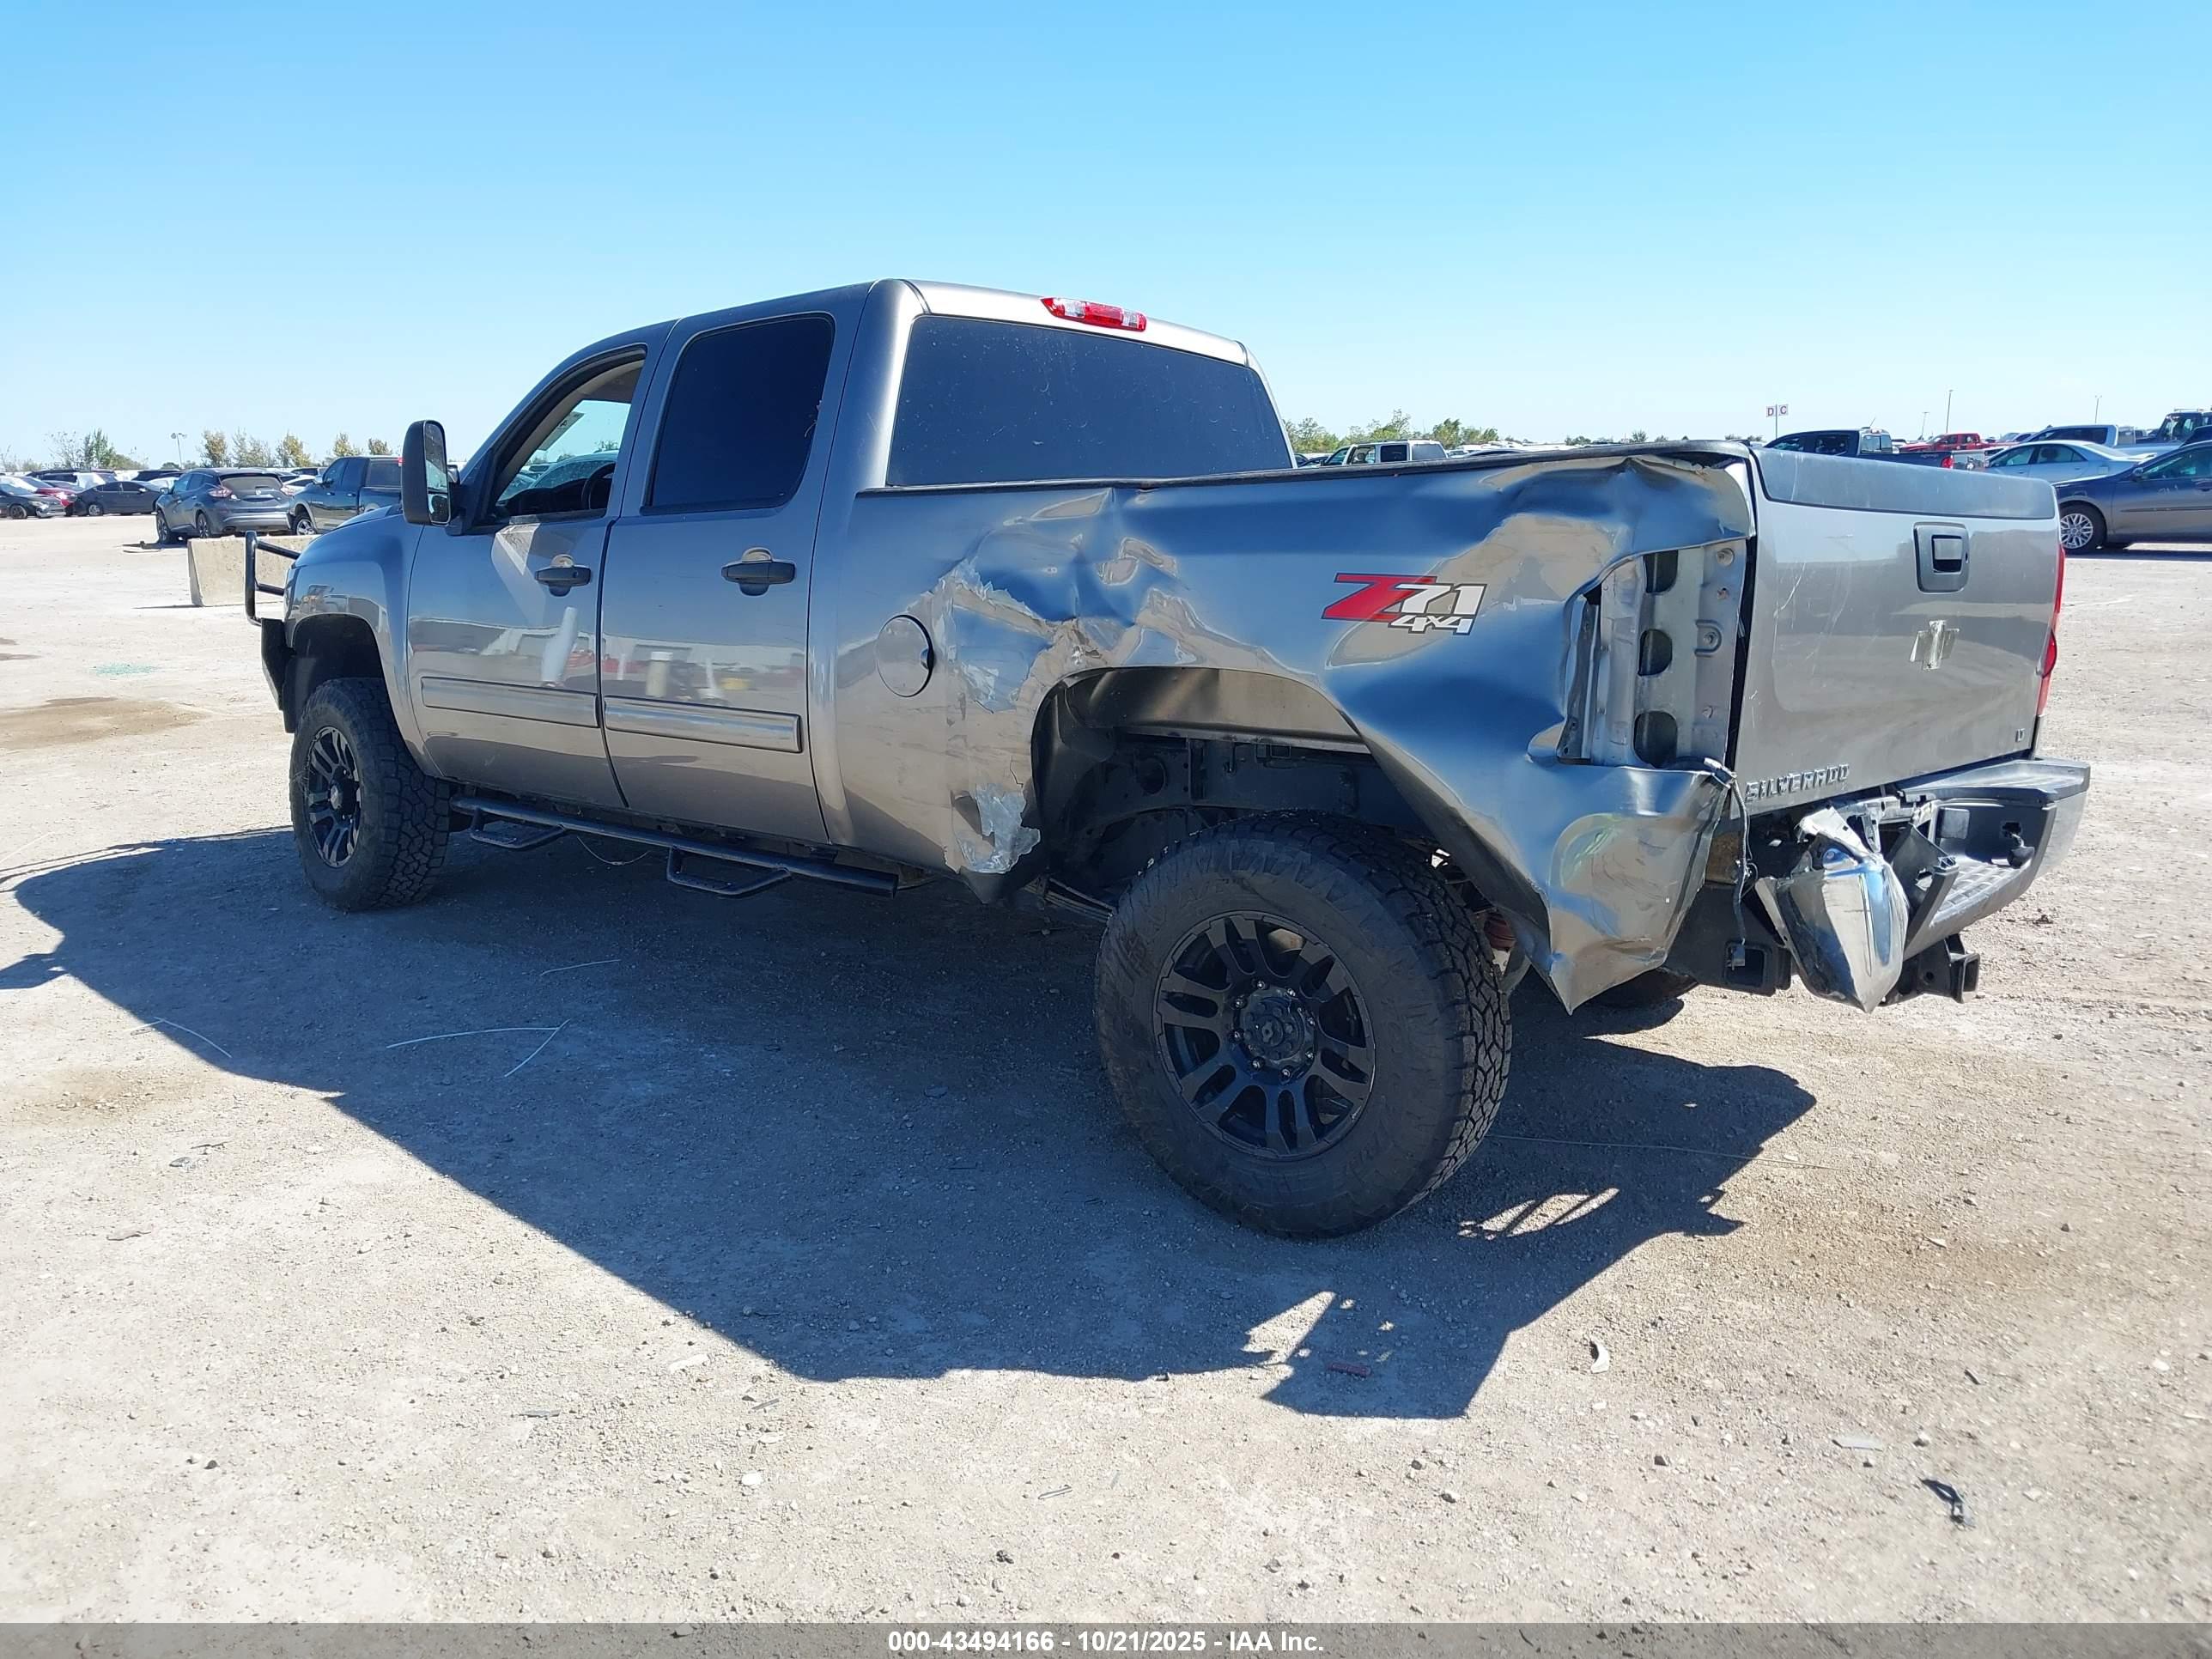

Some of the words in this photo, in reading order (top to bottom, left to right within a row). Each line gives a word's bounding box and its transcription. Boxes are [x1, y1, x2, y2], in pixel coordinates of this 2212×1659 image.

[1767, 407, 1774, 416] D
[1780, 405, 1787, 415] C
[1321, 572, 1488, 623] Z71
[1744, 763, 1850, 804] SILVERADO
